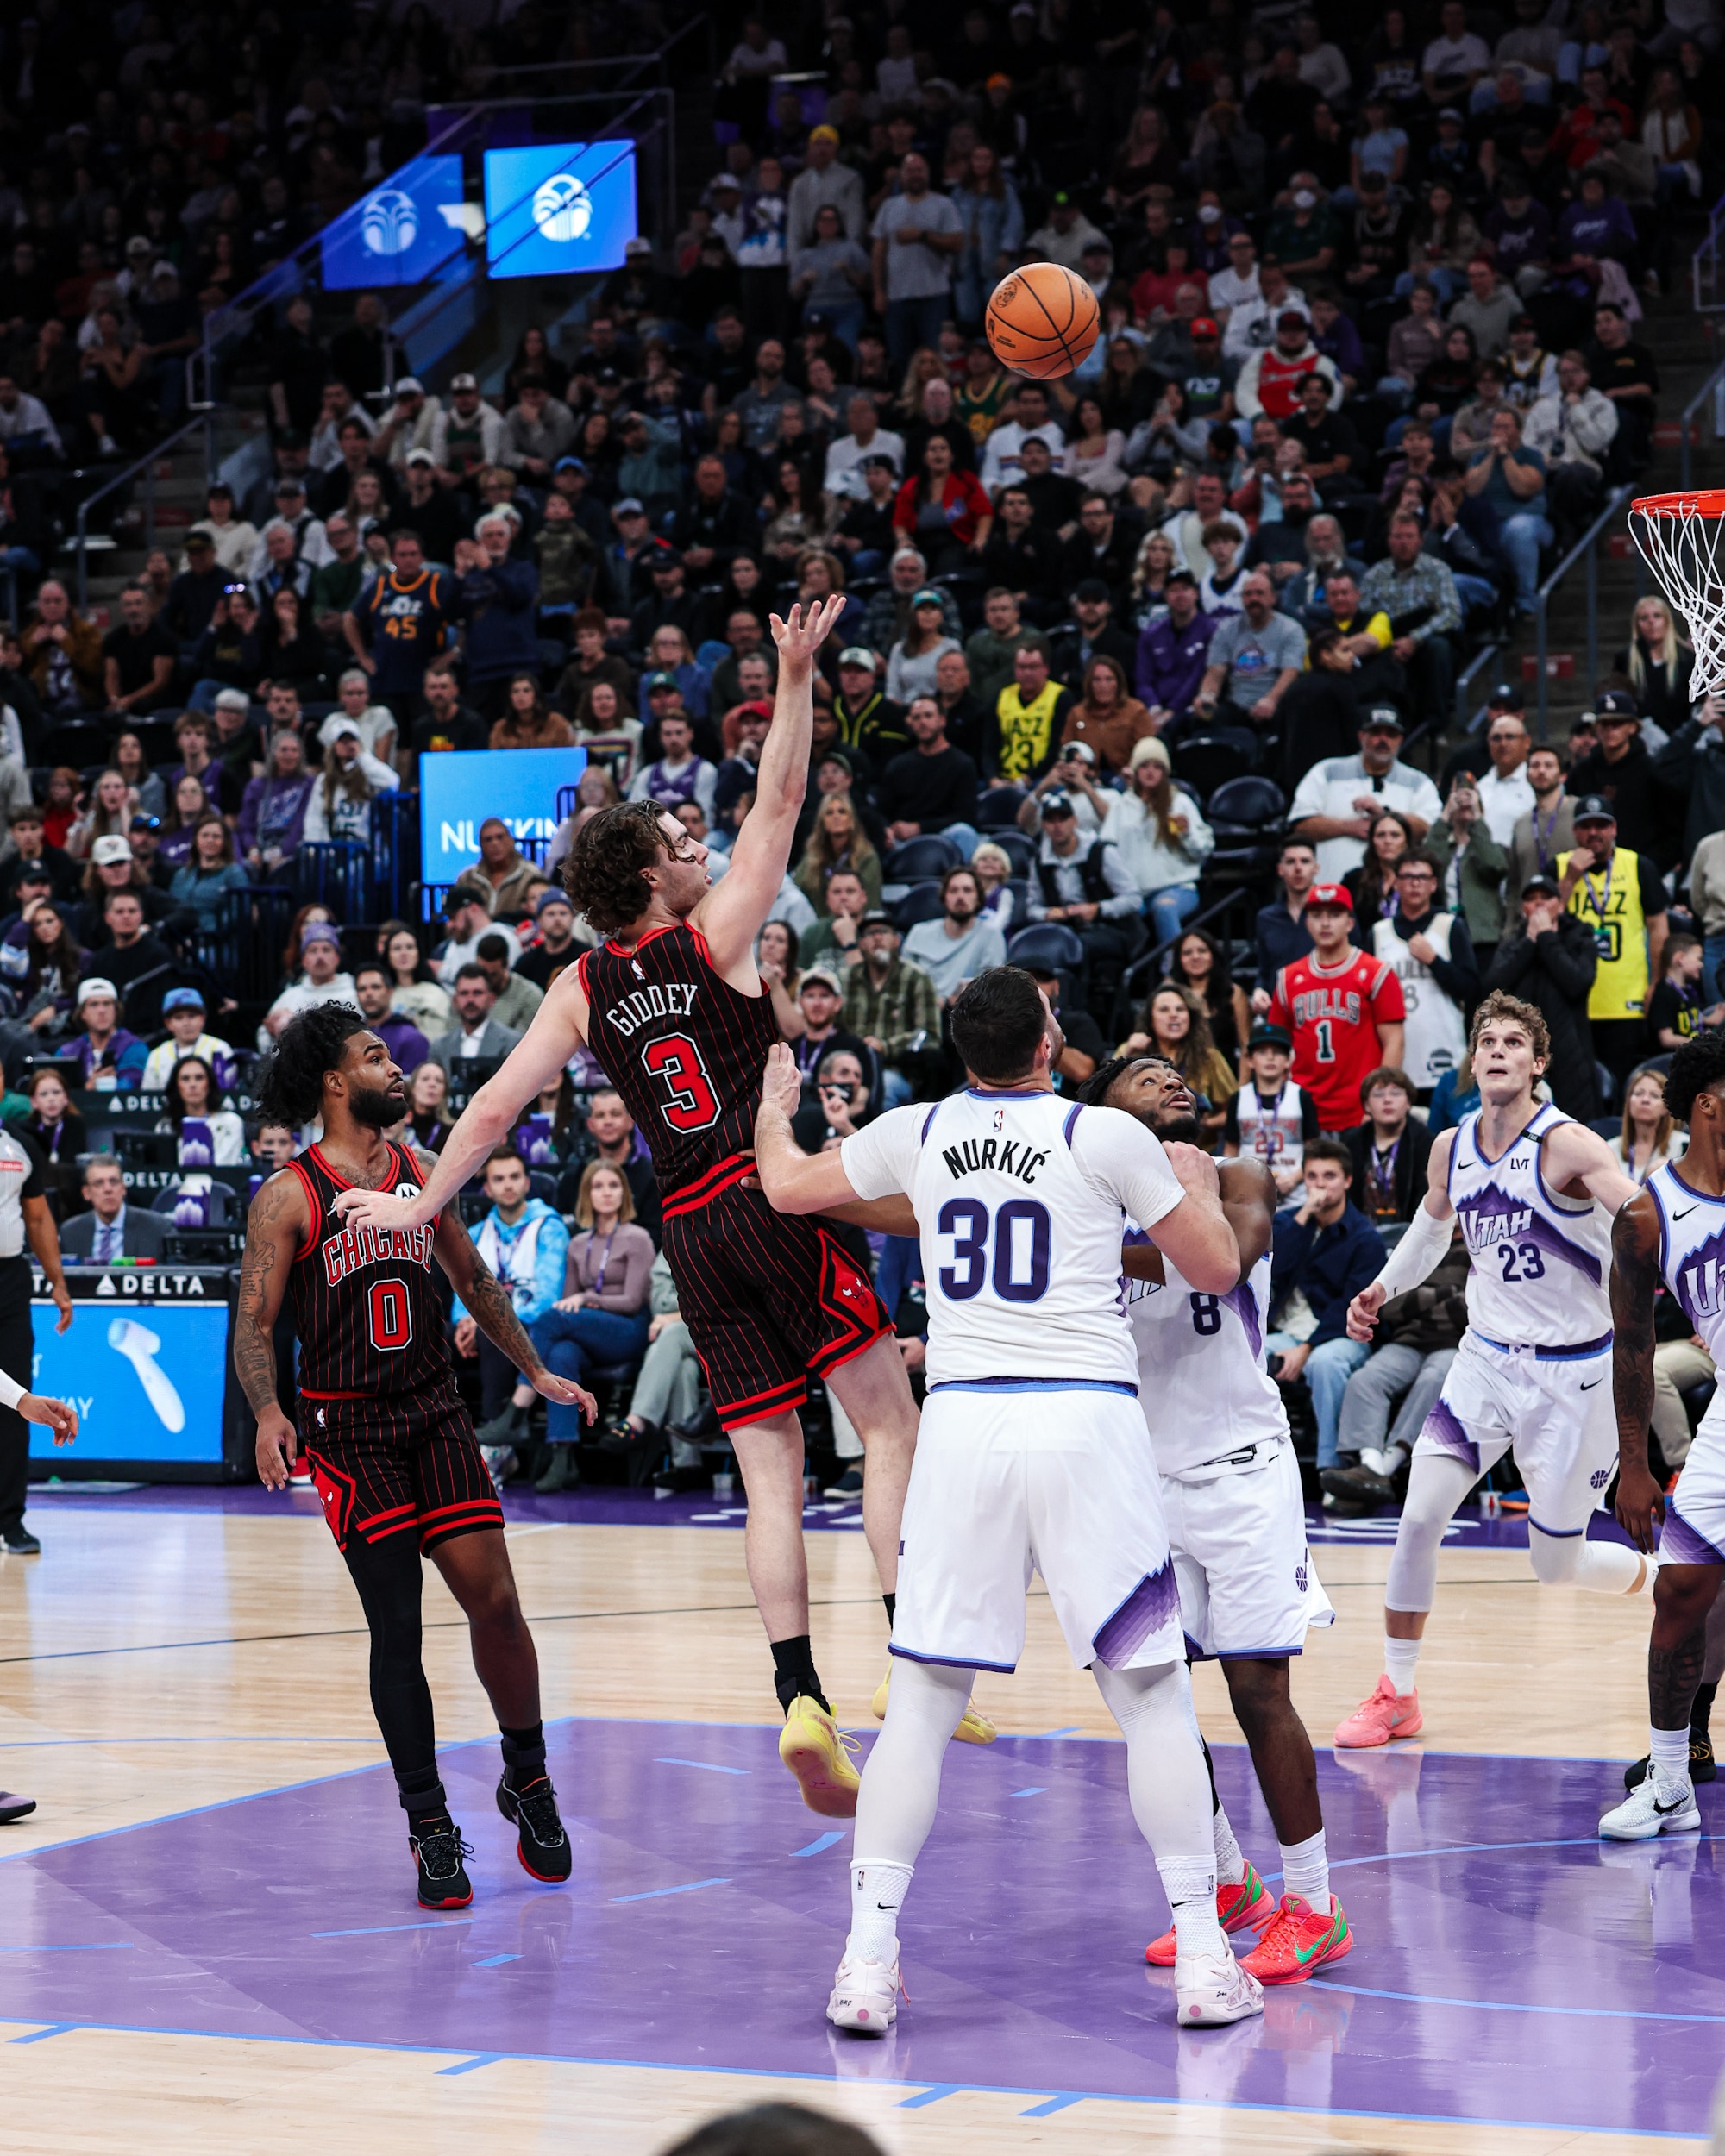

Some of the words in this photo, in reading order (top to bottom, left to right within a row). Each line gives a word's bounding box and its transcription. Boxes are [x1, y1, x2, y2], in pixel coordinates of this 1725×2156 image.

[385, 616, 417, 639] 45
[606, 983, 698, 1036] GIDDEY
[1293, 988, 1360, 1028] BULLS
[1315, 1019, 1335, 1063] 1
[127, 1095, 168, 1111] DEL
[641, 1031, 722, 1134] 3
[123, 1172, 182, 1188] DELTA
[942, 1138, 1052, 1184] NURKIĆ
[1510, 1158, 1530, 1170] LVT
[938, 1197, 1051, 1303] 30
[1458, 1208, 1534, 1255] UTAH
[322, 1224, 435, 1287] CHICAGO
[1497, 1243, 1545, 1282] 23
[122, 1275, 205, 1294] DELTA
[368, 1278, 413, 1351] 0
[1189, 1292, 1222, 1336] 8
